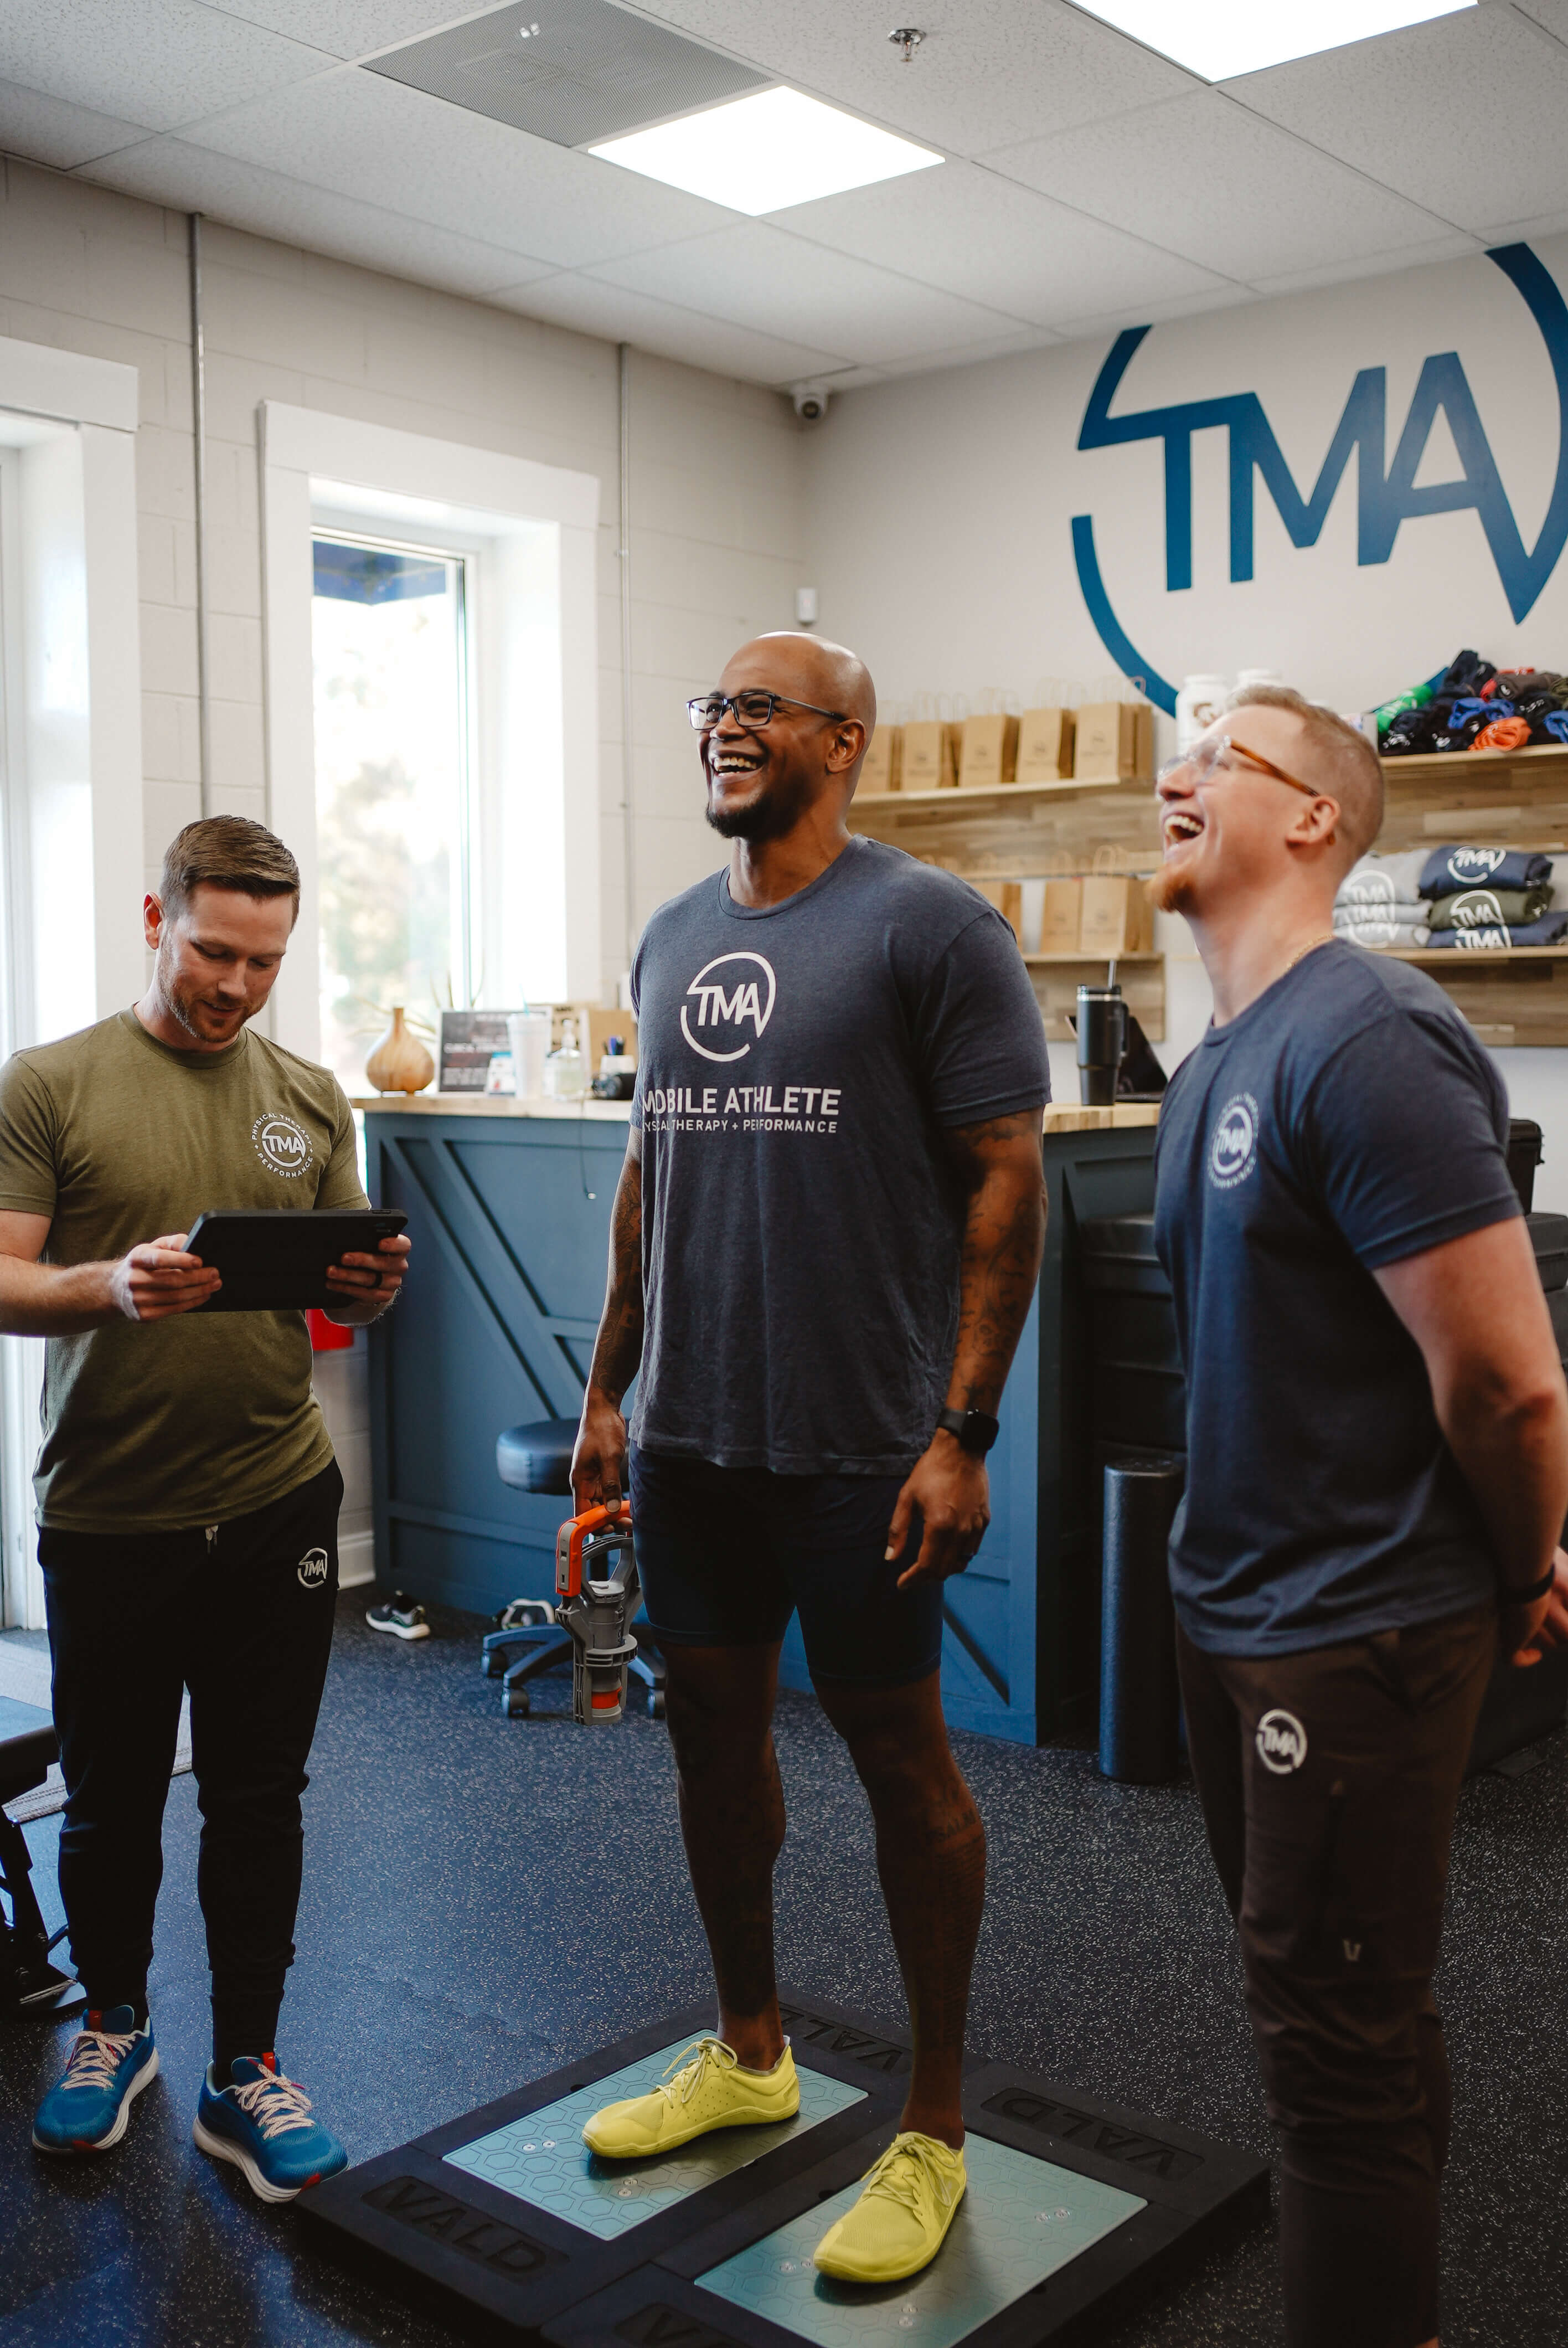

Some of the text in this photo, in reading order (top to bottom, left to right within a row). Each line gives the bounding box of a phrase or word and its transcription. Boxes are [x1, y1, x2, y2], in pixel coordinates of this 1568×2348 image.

[1077, 351, 1530, 625] TMA
[1451, 903, 1499, 928] TMA
[1456, 929, 1507, 949] TMA
[687, 982, 767, 1038] TMA
[642, 1086, 842, 1115] MOBILE ATHLETE
[251, 1113, 313, 1146] PHYSICAL THERAPY
[744, 1119, 838, 1134] PERFORMANCE
[262, 1135, 306, 1158] TMA
[257, 1152, 313, 1178] PERFORMANCE
[298, 1559, 327, 1579] TMA
[1002, 2098, 1176, 2176] VALD
[386, 2183, 546, 2273] VALD
